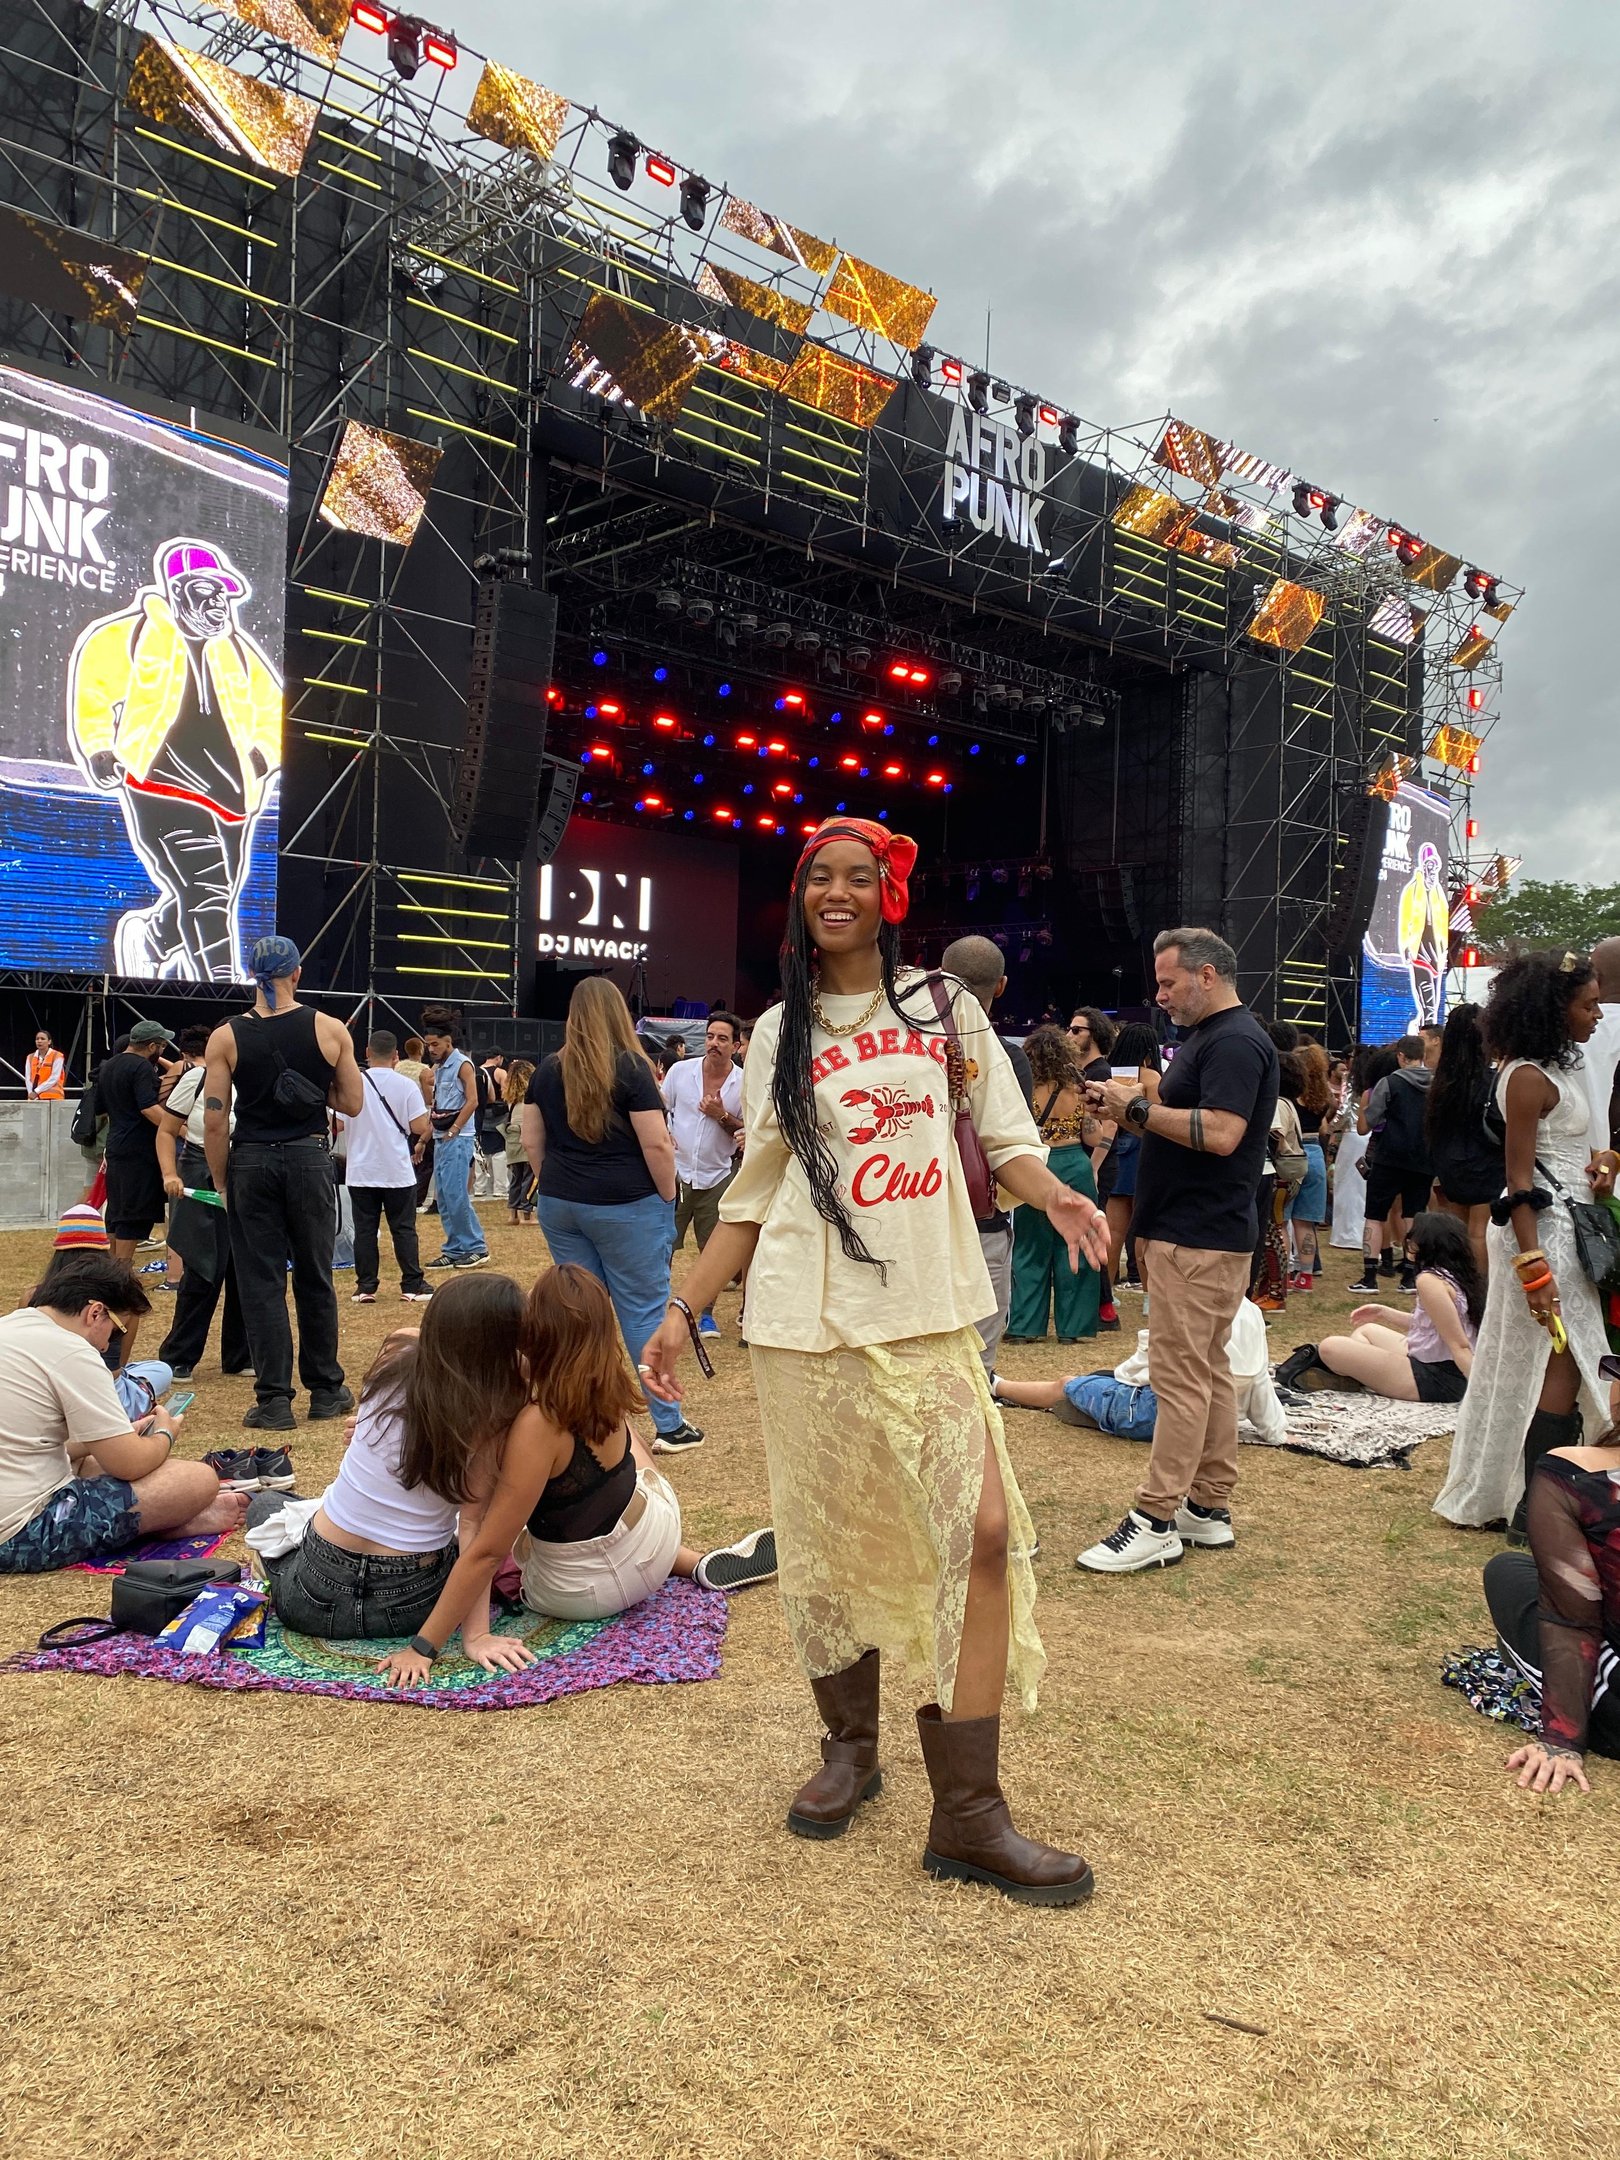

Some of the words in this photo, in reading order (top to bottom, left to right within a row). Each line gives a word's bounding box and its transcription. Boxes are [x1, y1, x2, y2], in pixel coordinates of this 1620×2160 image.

[946, 403, 1046, 493] AFRO
[943, 460, 1046, 554] PUNK
[1388, 801, 1412, 832] RO
[538, 933, 570, 954] DJ
[811, 1044, 852, 1087] HE
[852, 1027, 949, 1074] BEAC
[851, 1153, 943, 1208] Club
